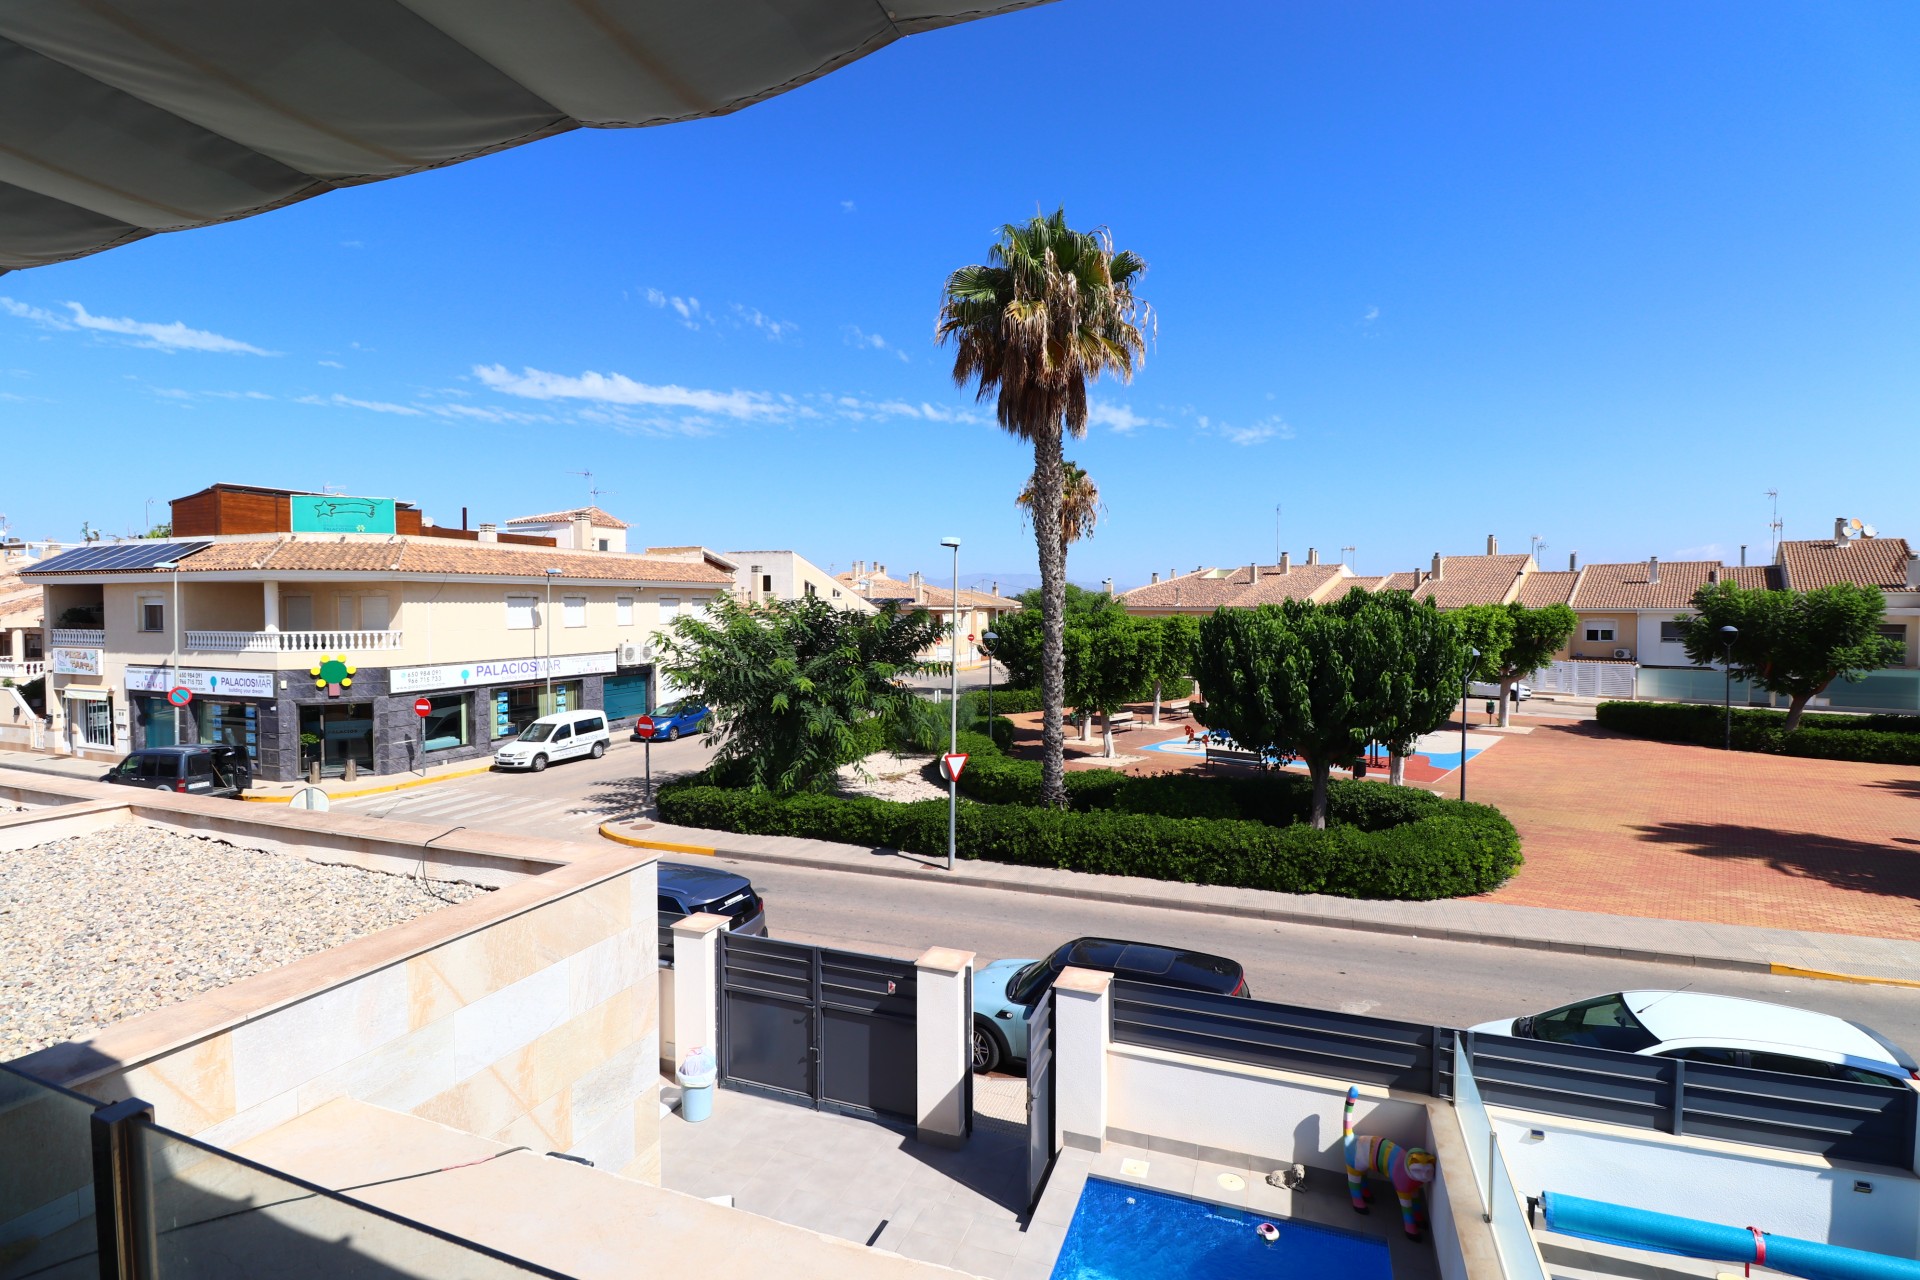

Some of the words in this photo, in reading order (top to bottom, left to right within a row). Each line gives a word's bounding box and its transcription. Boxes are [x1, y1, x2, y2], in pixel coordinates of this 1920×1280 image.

[65, 650, 89, 660] PIZZA
[70, 660, 95, 672] TARTA
[476, 659, 561, 677] PALACIOSMAR
[221, 677, 272, 688] PALACIOSMAR
